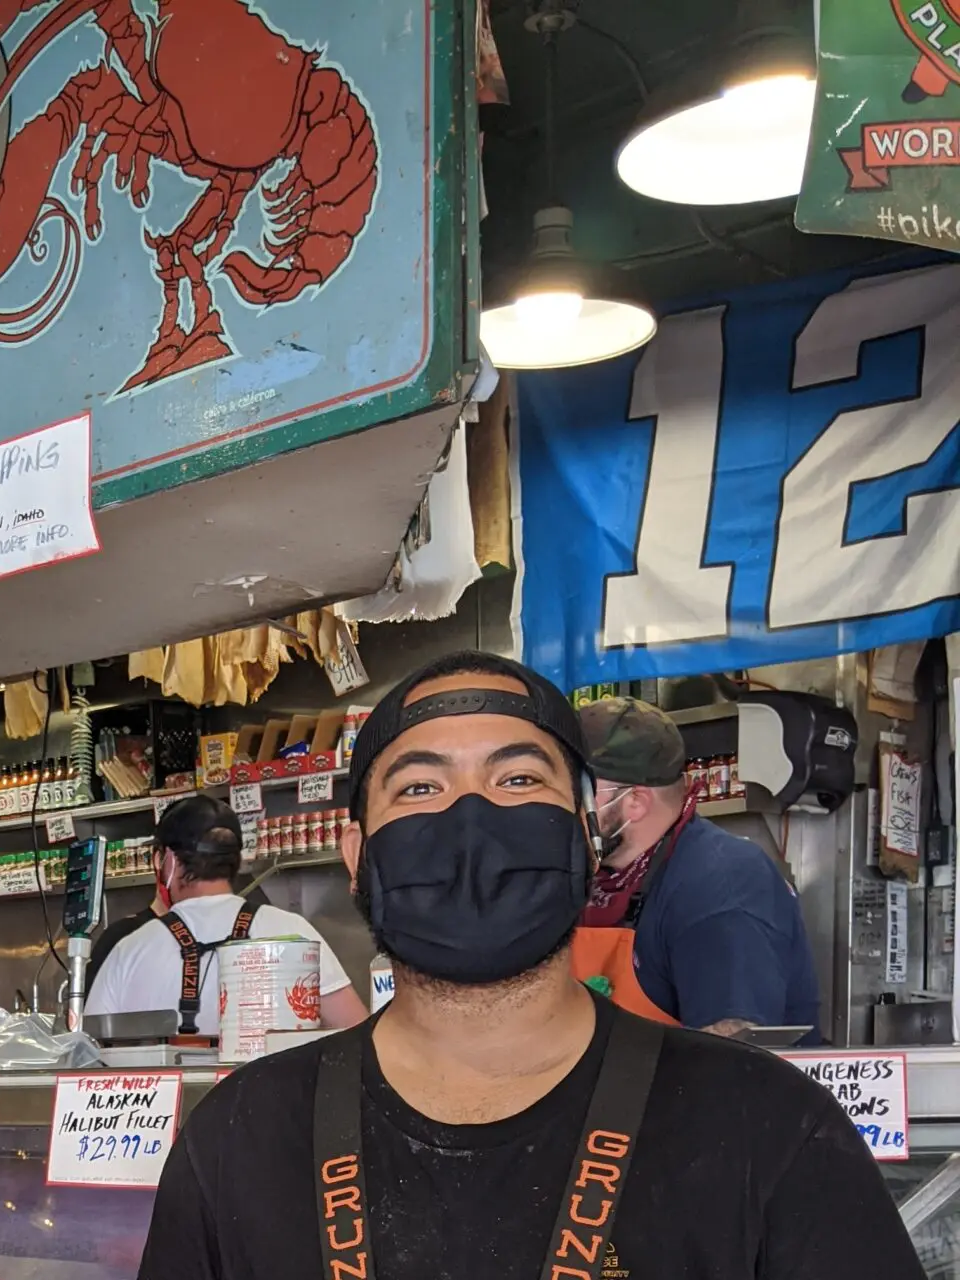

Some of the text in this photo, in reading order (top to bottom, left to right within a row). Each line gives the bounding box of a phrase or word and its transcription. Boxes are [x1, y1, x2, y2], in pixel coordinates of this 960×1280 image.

[870, 127, 960, 158] WOR
[601, 262, 960, 650] 12
[78, 1076, 161, 1092] FRESH! WILD!
[86, 1091, 157, 1111] ALASKAN
[59, 1109, 173, 1135] HALIBUT FILLET
[76, 1134, 141, 1161] $29.99
[883, 1131, 904, 1148] LB
